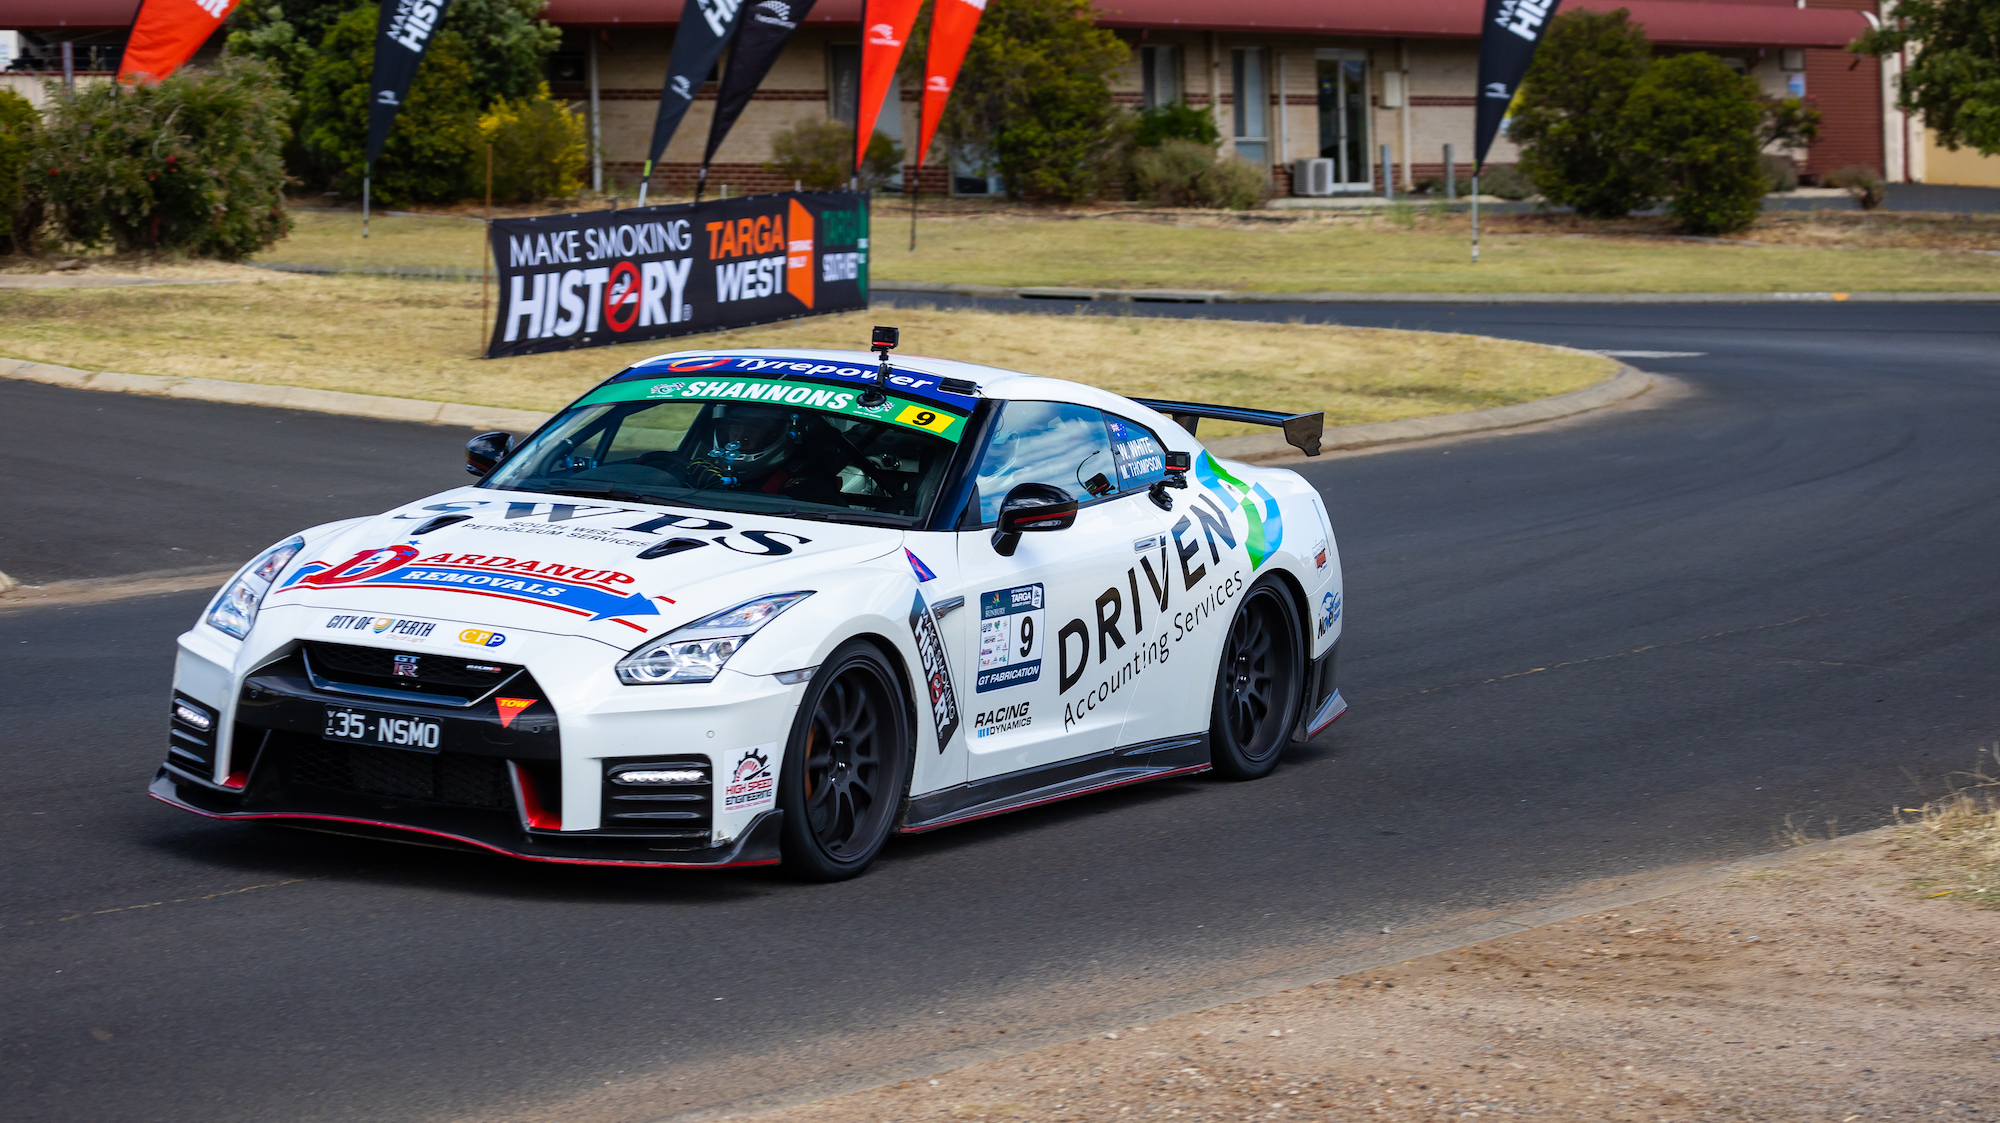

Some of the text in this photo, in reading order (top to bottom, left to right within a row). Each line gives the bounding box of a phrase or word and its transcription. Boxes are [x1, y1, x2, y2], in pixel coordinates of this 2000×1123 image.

[509, 219, 693, 268] MAKE SMOKING
[705, 213, 786, 261] TARGA
[715, 255, 787, 304] WEST
[681, 380, 855, 410] SHANNONS
[912, 411, 937, 426] 9
[1129, 437, 1153, 457] WHITE
[1128, 455, 1163, 477] THOMPSON
[392, 500, 814, 557] SWPS
[461, 522, 651, 549] PETROLEUM SERVICES
[507, 520, 621, 538] SOUTH WEST
[400, 570, 567, 599] REMOVALS
[1057, 492, 1238, 697] DRIVEN
[1010, 591, 1032, 603] TARGA
[326, 615, 437, 638] CITY OF PERTH
[460, 630, 505, 646] CPP
[1019, 615, 1034, 658] 9
[394, 654, 421, 663] GT
[1063, 569, 1244, 733] Accounting Services
[920, 606, 956, 721] MAKE SMOKING
[978, 665, 1040, 686] GT FABRICATION
[500, 699, 530, 709] TOW
[974, 701, 1030, 728] RACING
[989, 716, 1032, 736] DYNAMICS
[725, 778, 773, 795] HIGH SPEED
[725, 788, 772, 805] ENGINEERING
